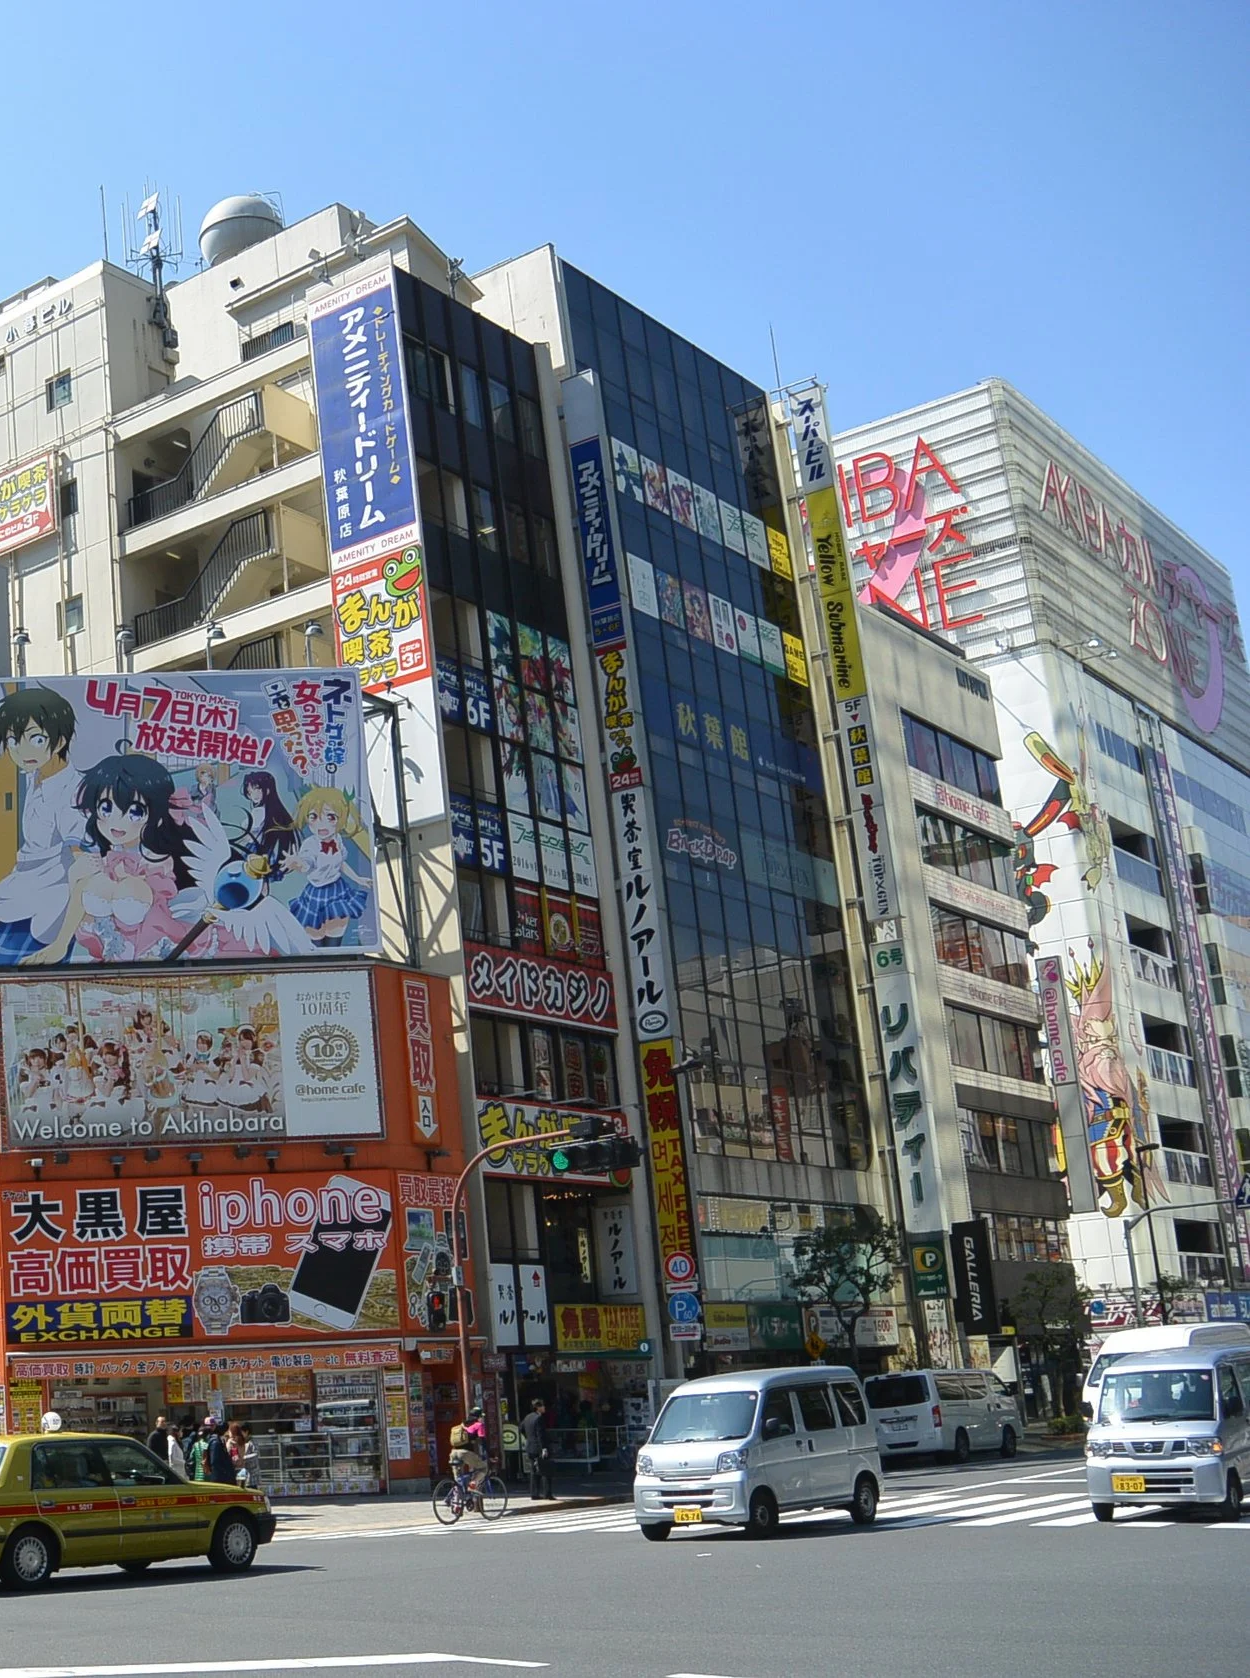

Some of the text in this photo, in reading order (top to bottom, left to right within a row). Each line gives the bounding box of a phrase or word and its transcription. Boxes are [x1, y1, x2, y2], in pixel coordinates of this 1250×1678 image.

[314, 274, 387, 314] AMENITY DREAM
[339, 304, 386, 534] アメニティードリーム
[333, 467, 352, 538] 秋葉原店
[837, 436, 961, 527] IBA
[337, 529, 414, 566] AMENITY DREAM
[815, 533, 837, 587] Yellow
[338, 594, 421, 638] まんが
[342, 631, 393, 666] 喫茶
[402, 652, 422, 669] 3F
[826, 601, 852, 690] Submarine
[175, 690, 207, 702] TOKYO
[358, 663, 398, 689] ラゲラ
[600, 651, 627, 713] まんが
[467, 697, 491, 729] 6F
[844, 699, 861, 712] 5F
[134, 721, 272, 766] 放送開始!
[677, 703, 749, 761] 秋葉館
[849, 727, 871, 784] 秋葉館
[480, 836, 505, 870] 5F
[619, 793, 664, 1006] 喫茶室ルノアール
[295, 990, 351, 1002] おかげさまで
[301, 1001, 348, 1016] 10周年
[470, 954, 608, 1021] メイドカジノ
[405, 983, 434, 1092] 買取
[1043, 988, 1067, 1082] @home cafe
[296, 1083, 366, 1096] @home cafe
[642, 1047, 680, 1133] 免税
[881, 1003, 926, 1203] リバティー
[13, 1113, 285, 1141] Welcome to Akihabara
[421, 1099, 431, 1128] 入口
[12, 1186, 189, 1243] 大黒屋
[199, 1178, 383, 1233] iphone
[668, 1138, 691, 1256] TAX FREE
[203, 1231, 387, 1256] 携帯 スマホ
[607, 1221, 627, 1291] ルノアール
[671, 1257, 689, 1274] 40
[9, 1246, 192, 1297] 高価買取
[963, 1236, 983, 1322] GALLERIA
[11, 1298, 188, 1331] 外貨両替
[603, 1307, 640, 1328] TAX FREE
[675, 1300, 687, 1319] P
[20, 1326, 181, 1344] EXCHANGE
[15, 1350, 398, 1378] 高価買取 無料査定
